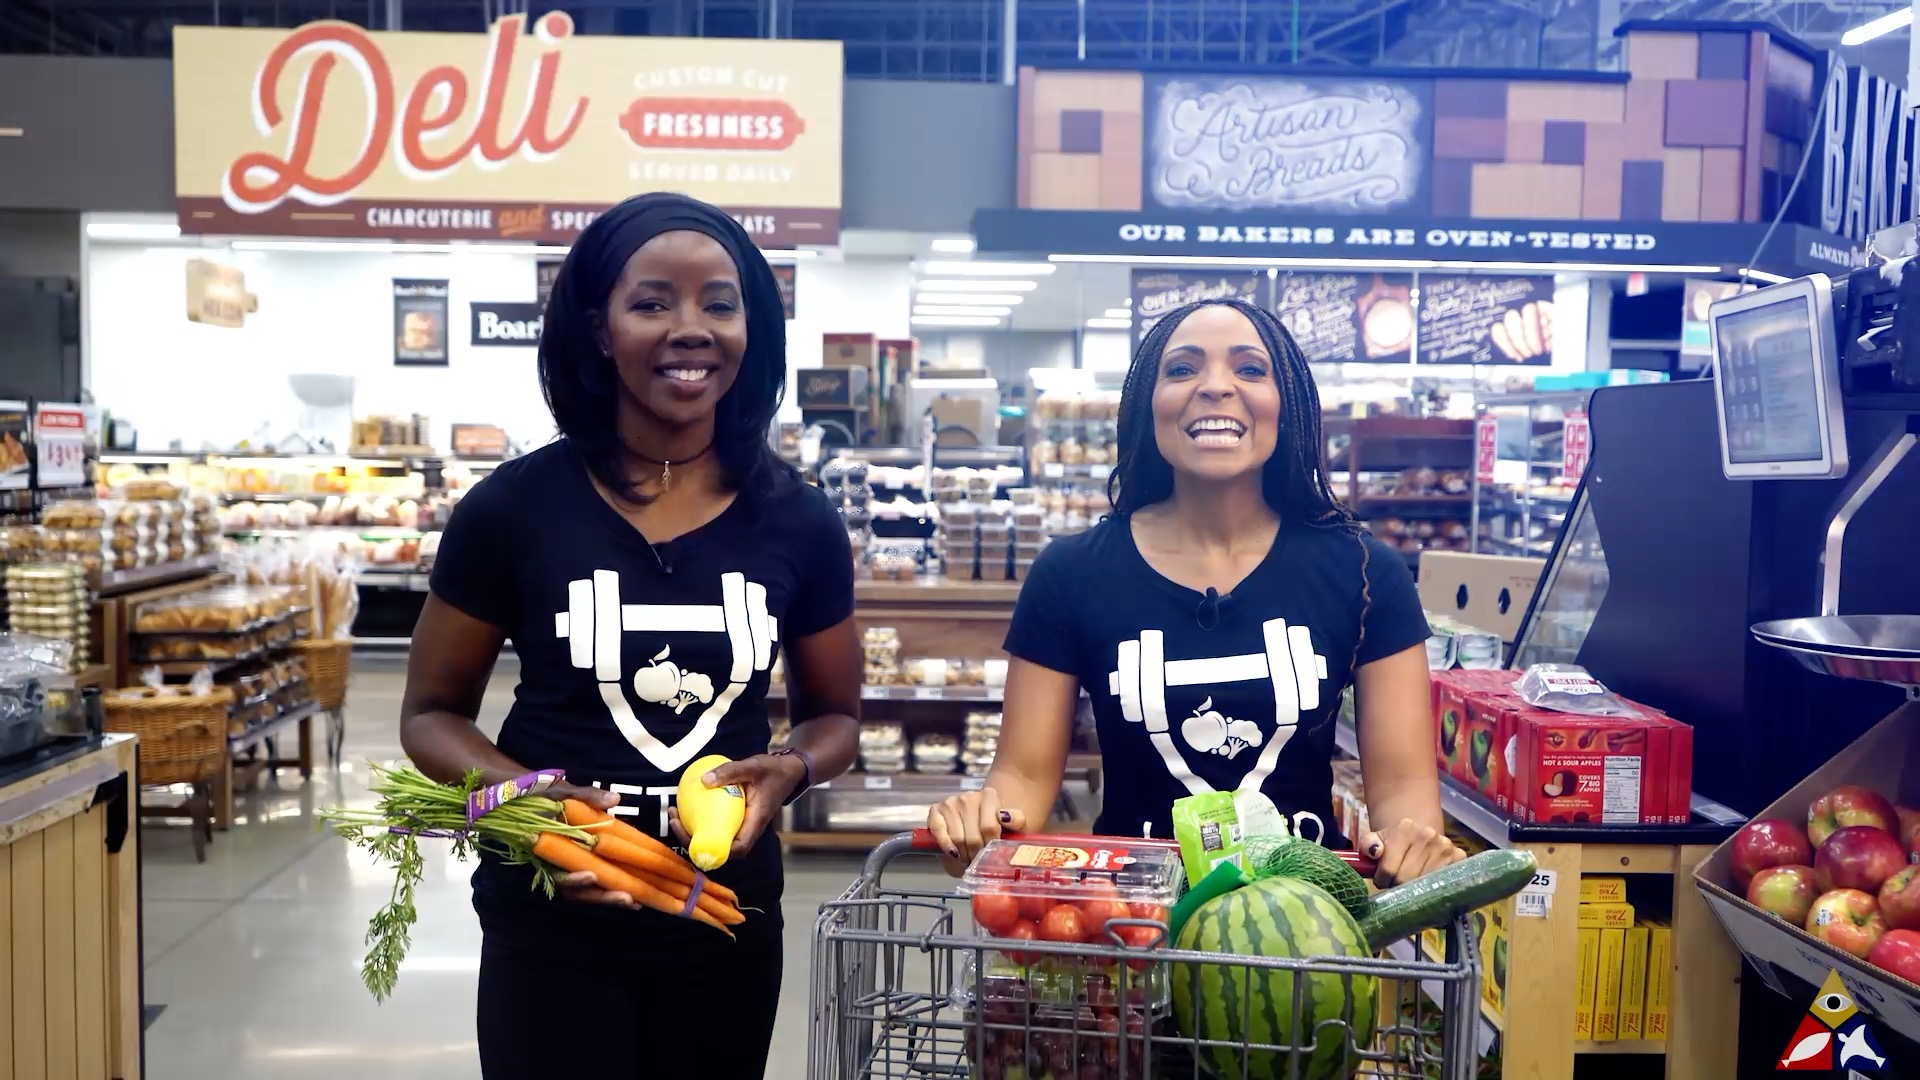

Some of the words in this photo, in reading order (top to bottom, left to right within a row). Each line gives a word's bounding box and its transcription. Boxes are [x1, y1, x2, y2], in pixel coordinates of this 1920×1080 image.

[634, 66, 733, 91] CUSTOM
[743, 70, 790, 92] CUT
[223, 12, 590, 212] Deli
[643, 112, 784, 140] FRESHNESS
[1173, 93, 1358, 161] Artisan
[629, 161, 718, 183] SERVED
[726, 163, 793, 183] DAILY
[1228, 137, 1379, 197] Breads
[366, 207, 493, 229] CHARCUTERIE
[500, 203, 545, 237] and
[1119, 224, 1186, 242] OUR
[1197, 225, 1335, 245] BAKERS
[1345, 228, 1415, 246] ARE
[1426, 229, 1656, 250] OVEN-TESTED
[1810, 242, 1850, 267] ALWAYS
[1579, 780, 1588, 792] 7
[1610, 883, 1619, 895] 7
[1618, 910, 1626, 920] 7
[1578, 1024, 1588, 1033] 7
[1603, 1025, 1614, 1033] 7
[1627, 1024, 1638, 1033] 7
[1654, 1025, 1664, 1034] 7
